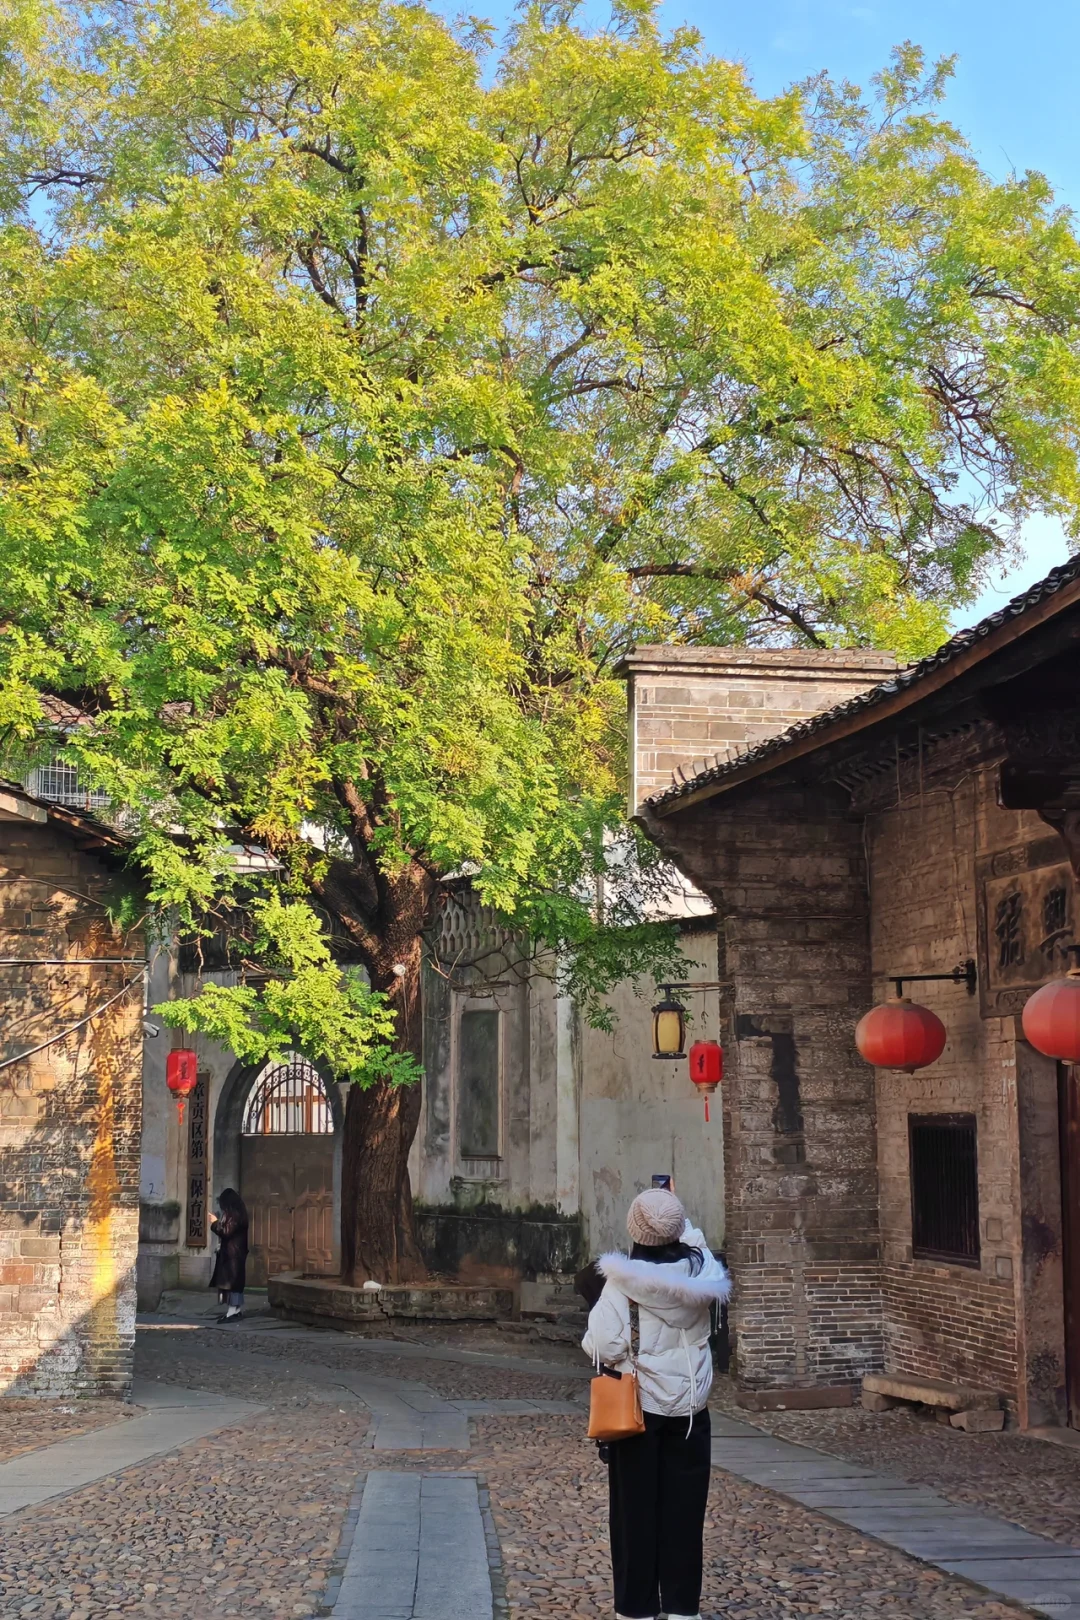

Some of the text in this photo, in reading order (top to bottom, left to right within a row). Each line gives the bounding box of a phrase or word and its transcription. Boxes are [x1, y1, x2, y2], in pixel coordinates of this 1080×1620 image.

[189, 1082, 205, 1238] 章贡区第二保育院
